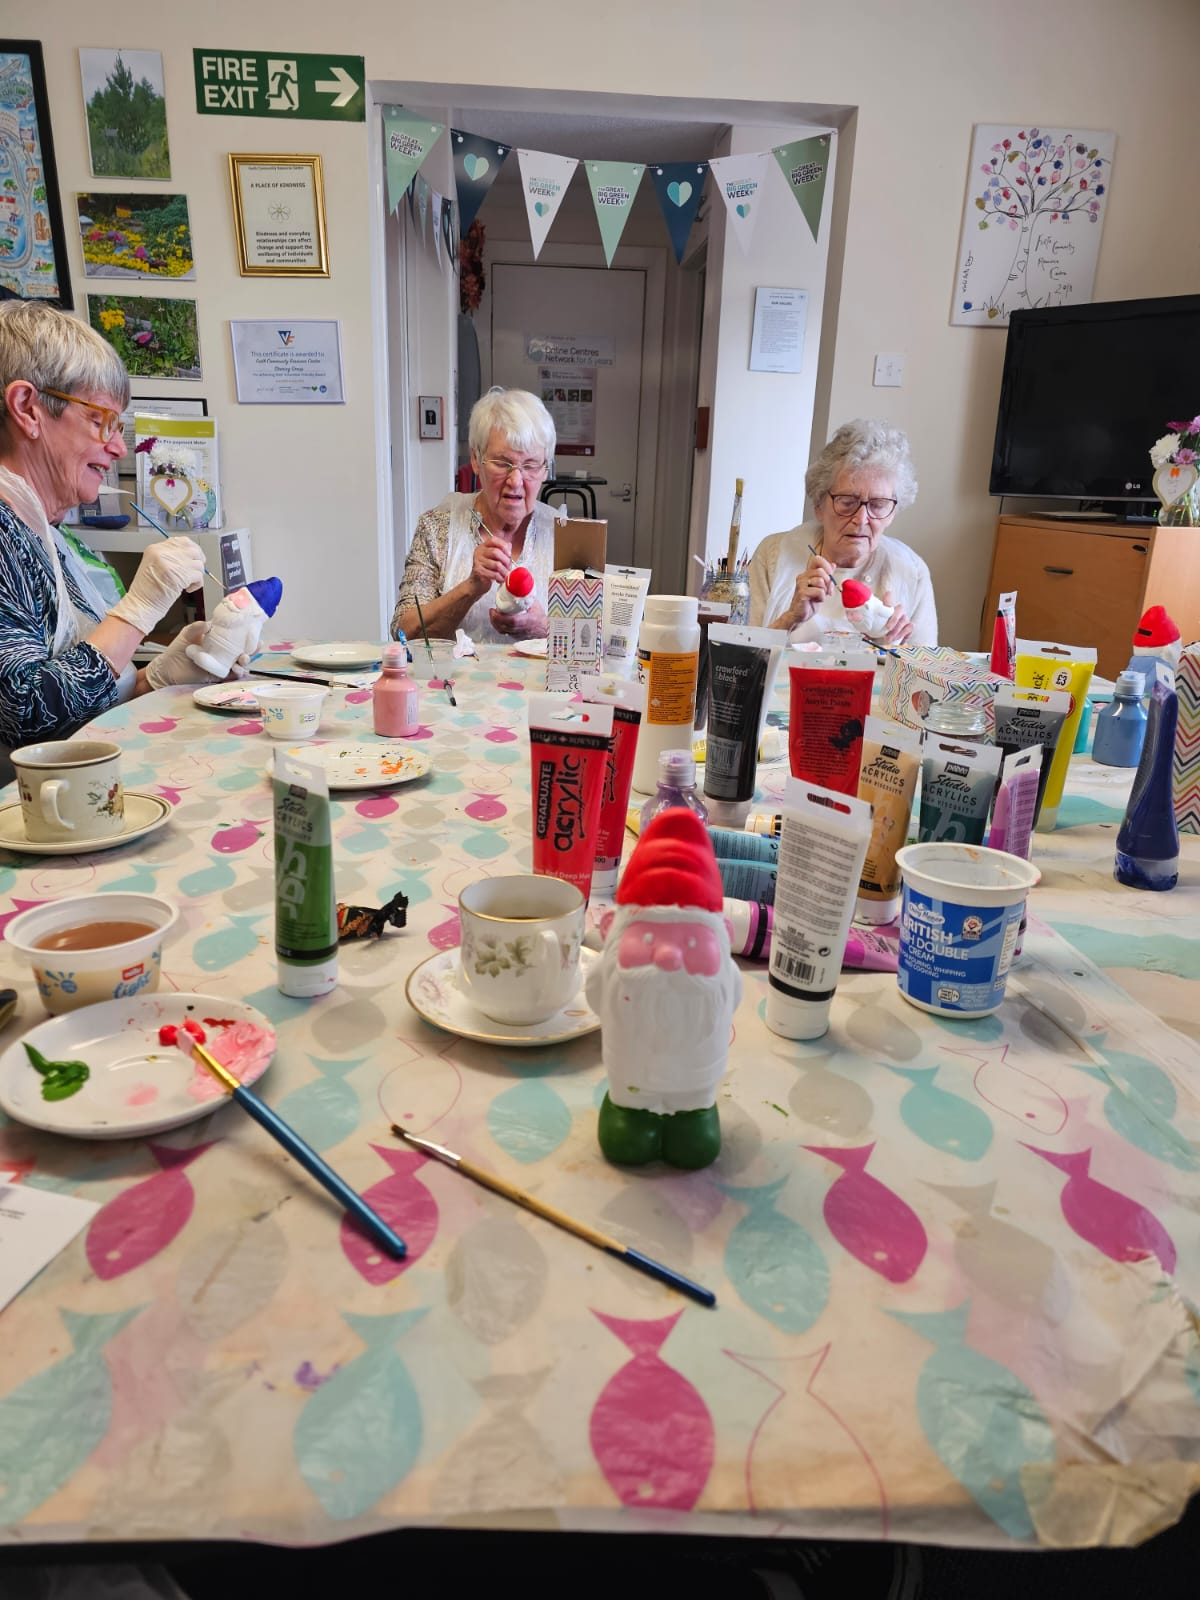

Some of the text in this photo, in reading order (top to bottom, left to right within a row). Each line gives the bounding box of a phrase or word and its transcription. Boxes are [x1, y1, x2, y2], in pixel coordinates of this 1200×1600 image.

[202, 56, 258, 81] FIRE
[204, 85, 259, 109] EXIT
[390, 141, 412, 156] WEEK
[792, 174, 815, 185] WEEK
[529, 187, 553, 197] WEEK
[727, 190, 750, 199] WEEK
[598, 197, 620, 205] WEEK
[570, 347, 599, 357] Centres
[715, 664, 749, 677] crawford
[718, 672, 737, 684] black
[1056, 674, 1068, 687] £3
[1004, 717, 1046, 729] Studio
[998, 727, 1053, 740] ACRYLICS
[868, 757, 901, 774] Studio
[861, 766, 905, 788] ACRYLICS
[929, 774, 971, 793] Studio
[537, 762, 553, 834] GRADUATE
[923, 783, 977, 806] ACRYLICS
[554, 753, 583, 852] acrylic
[904, 913, 953, 945] BRITISH
[908, 945, 935, 963] CREAM
[916, 937, 969, 961] DOUBLE
[912, 963, 940, 978] COOKING
[933, 965, 966, 978] WHIPPING
